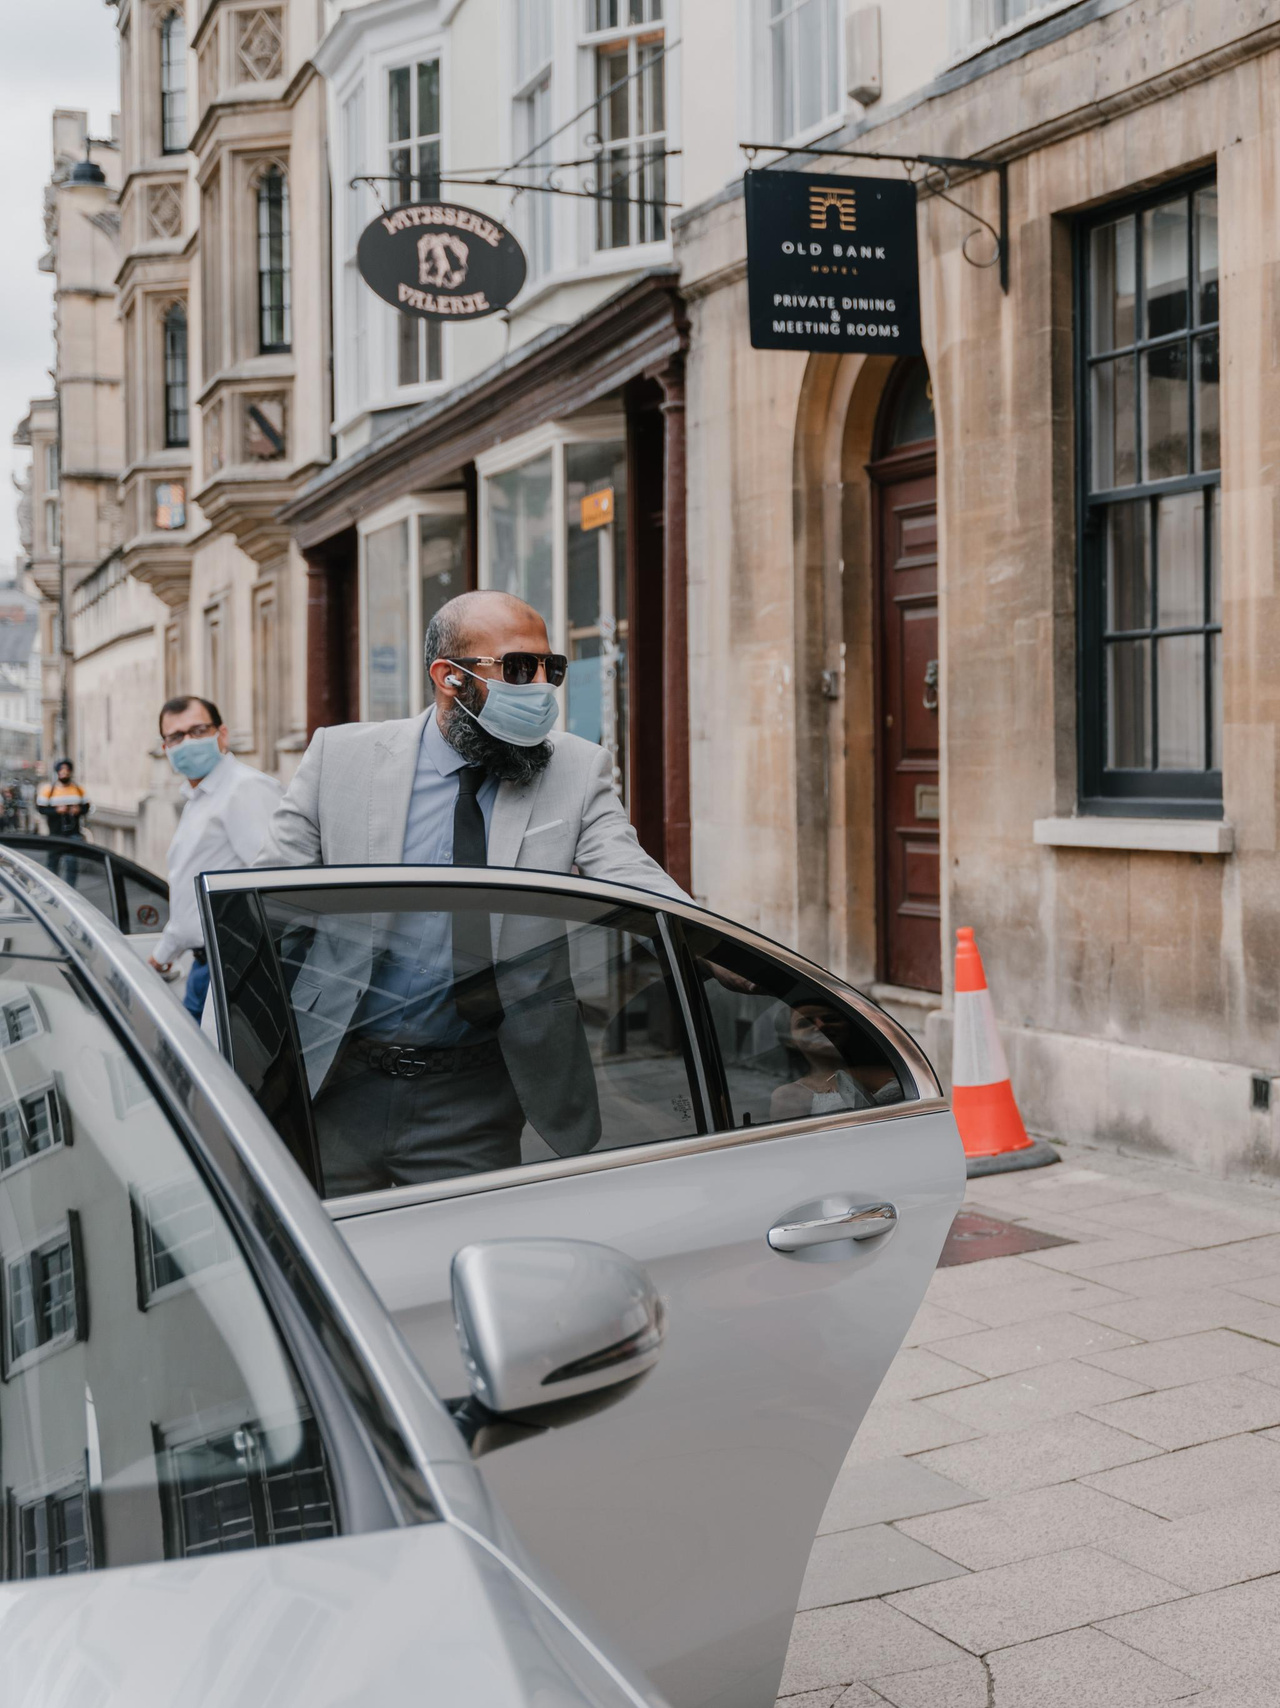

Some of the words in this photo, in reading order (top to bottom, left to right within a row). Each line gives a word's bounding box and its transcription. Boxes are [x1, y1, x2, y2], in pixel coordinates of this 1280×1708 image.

[381, 206, 505, 248] PATISSERIE
[781, 241, 823, 256] OLD
[832, 244, 886, 260] BANK
[811, 265, 859, 275] HOTEL
[398, 282, 491, 315] VALERIE
[773, 293, 836, 309] PRIVATE
[841, 297, 896, 312] DINING
[830, 309, 841, 322] &
[772, 320, 841, 335] MEETING
[846, 323, 900, 338] ROOMS
